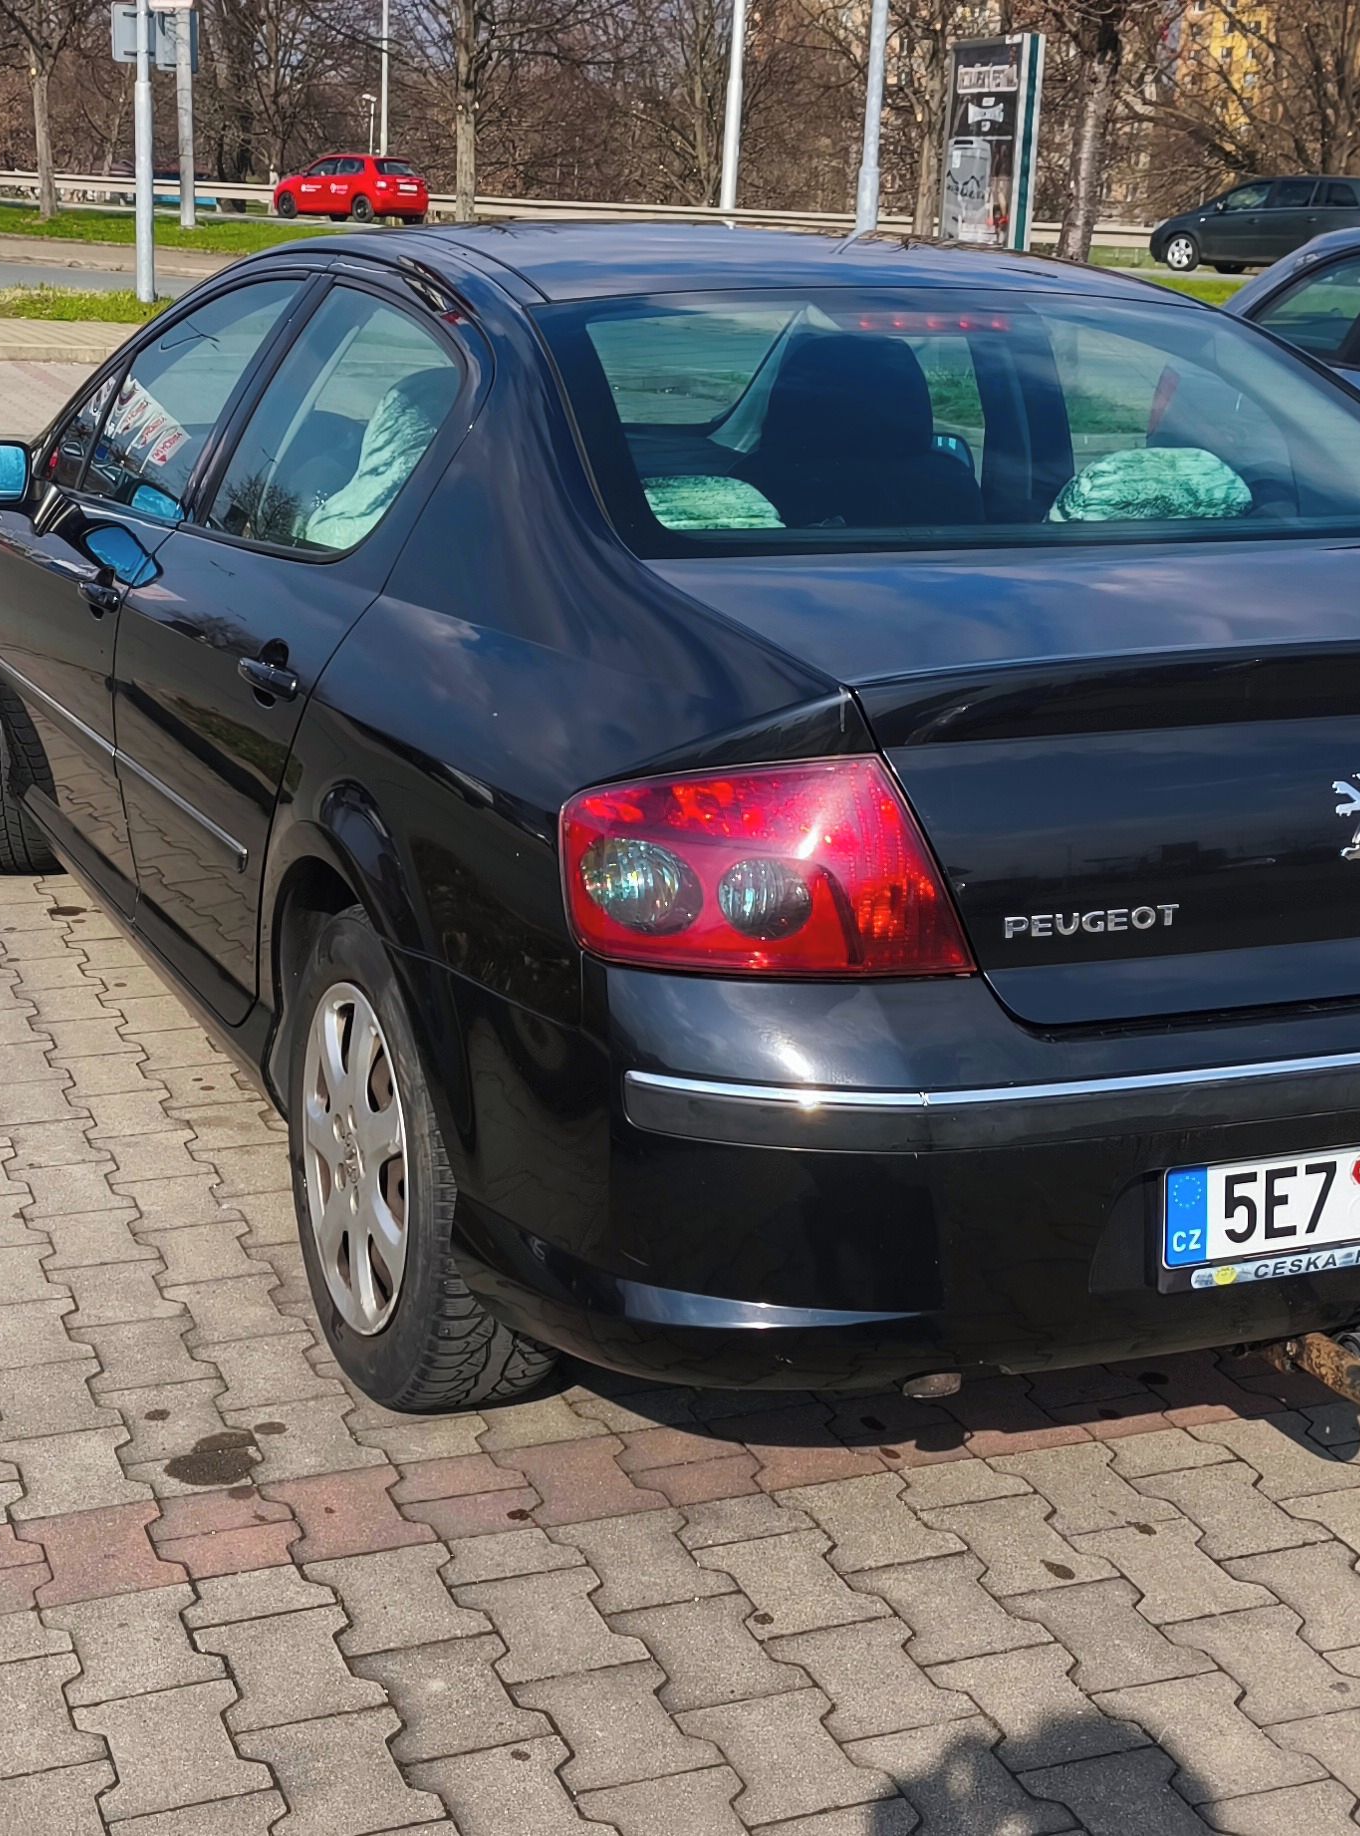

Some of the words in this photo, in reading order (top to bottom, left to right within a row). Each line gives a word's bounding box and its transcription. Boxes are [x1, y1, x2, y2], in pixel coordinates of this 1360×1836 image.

[1004, 904, 1180, 939] PEUGEOT
[1224, 1160, 1337, 1243] 5E7
[1172, 1228, 1202, 1252] CZ
